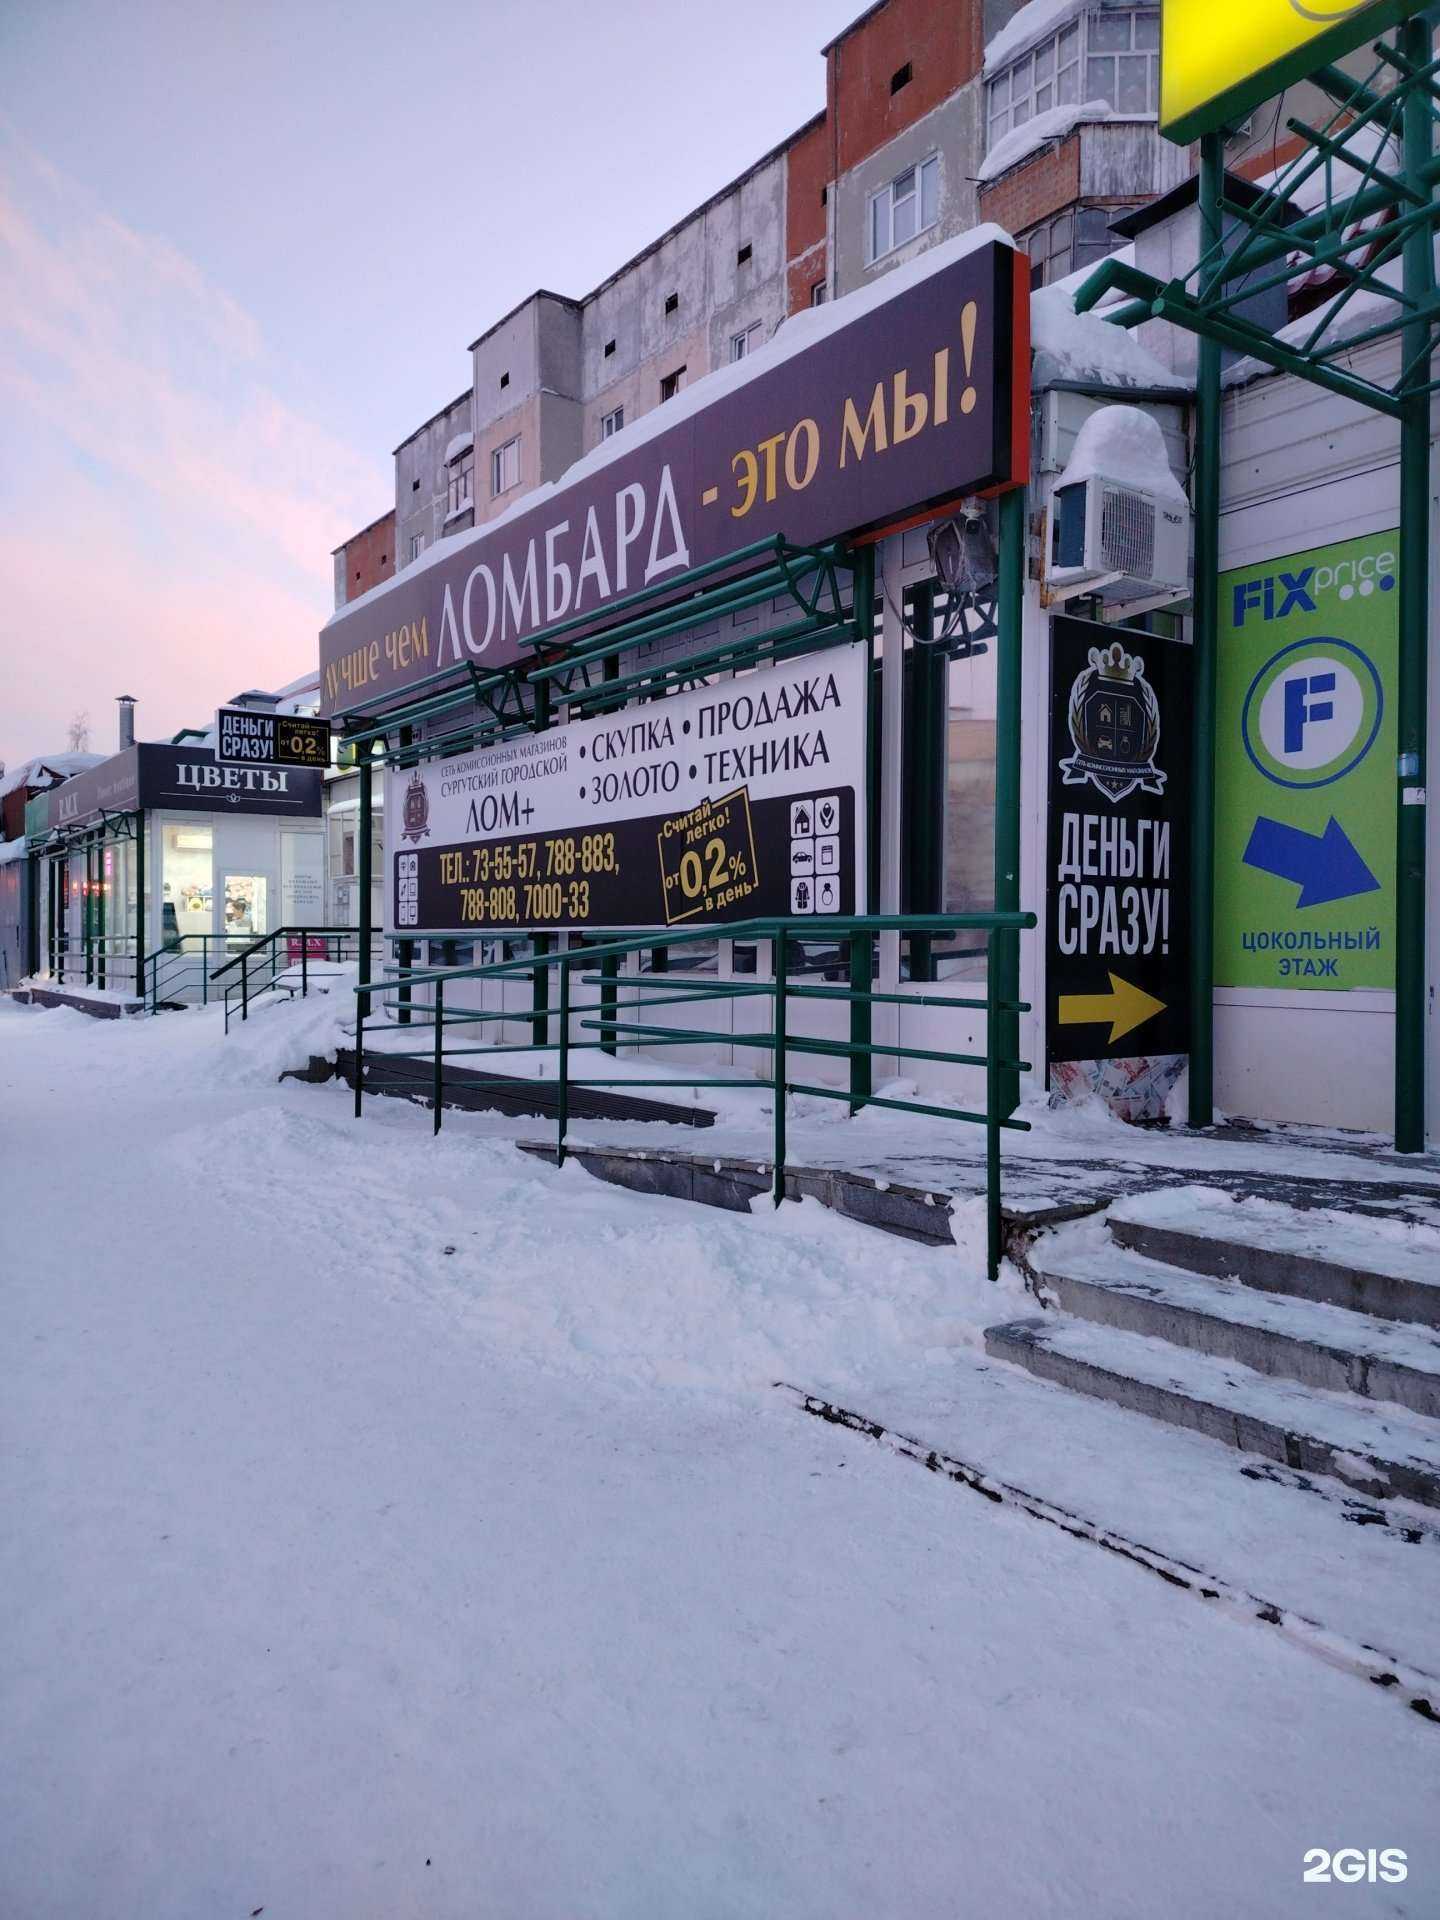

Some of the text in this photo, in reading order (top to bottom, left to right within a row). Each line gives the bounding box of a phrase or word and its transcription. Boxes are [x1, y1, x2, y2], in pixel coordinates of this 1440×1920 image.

[437, 464, 690, 667] ЛОМБАРД
[222, 715, 274, 738] ДЕНЬГИ
[592, 673, 841, 762] СКУПКА ПРОДАЖА
[1284, 672, 1336, 753] F
[222, 736, 274, 760] СРАЗУ!
[441, 735, 568, 778] СЕТЬ КОМИССИОННЫХ МАГАЗИНОВ
[591, 729, 830, 804] ЗОЛОТО ТЕХНИКА
[176, 764, 288, 792] ЦВЕТЫ
[441, 753, 567, 798] СУРГУТСКИЙ ГОРОДСКОЙ
[465, 790, 535, 834] ЛОМ+
[663, 799, 711, 838] Считай
[686, 806, 730, 844] легко!
[473, 842, 541, 882] 73-55-57,
[545, 832, 620, 876] 788-883,
[1057, 812, 1170, 882] ДЕНЬГИ
[460, 880, 590, 924] 788-808, 7000-33
[665, 872, 680, 889] от
[705, 882, 752, 911] в день
[1057, 885, 1170, 956] СРАЗУ!
[1242, 926, 1381, 953] ЦОКОЛЬНЫЙ
[1279, 958, 1338, 977] ЭТАЖ
